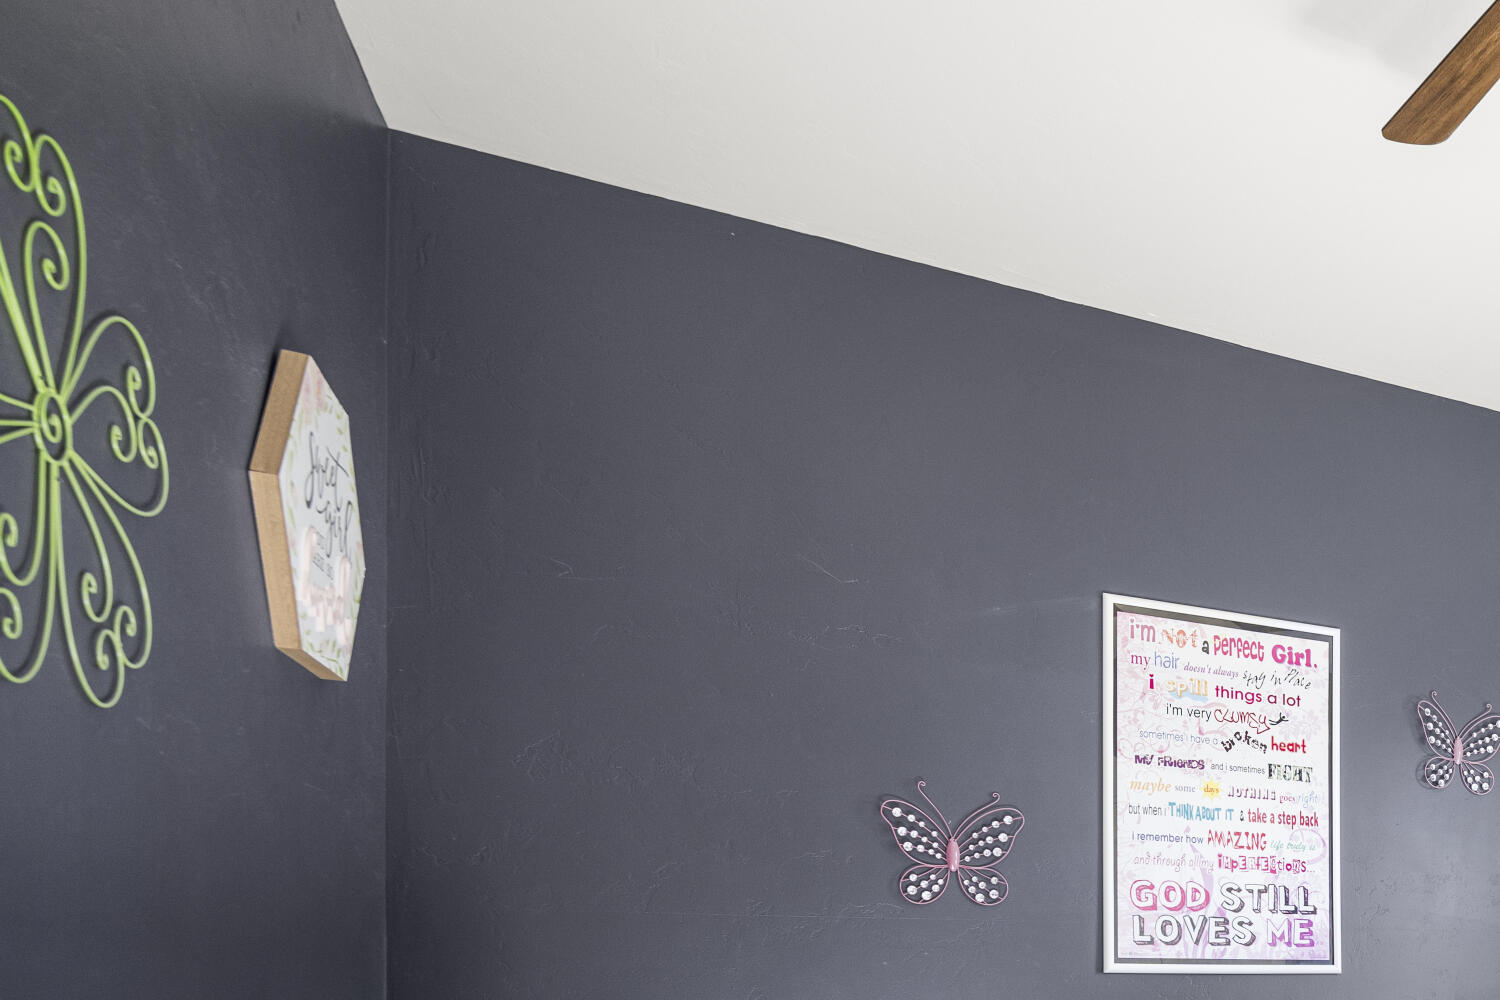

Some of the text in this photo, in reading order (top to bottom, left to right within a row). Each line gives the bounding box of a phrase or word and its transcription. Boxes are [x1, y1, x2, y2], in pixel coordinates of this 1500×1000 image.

[1130, 618, 1156, 642] i'm
[1201, 640, 1210, 654] a
[1271, 644, 1318, 669] Girl.
[1131, 654, 1151, 670] my
[1154, 651, 1180, 669] hair
[1184, 662, 1211, 674] doesn't
[1213, 666, 1239, 679] always
[1243, 670, 1266, 690] stay
[1271, 670, 1281, 686] in
[1149, 673, 1301, 707] i spill things a lot
[1166, 703, 1183, 717] i'm
[1187, 707, 1212, 722] very
[1139, 730, 1184, 742] sometimes
[1190, 734, 1211, 744] have
[1220, 730, 1268, 754] broken
[1271, 736, 1307, 754] heart
[1211, 763, 1224, 771] and
[1229, 764, 1266, 775] sometimes
[1268, 763, 1313, 783] FIGHT
[1129, 777, 1172, 796] maybe
[1174, 785, 1196, 793] some
[1203, 784, 1219, 795] days
[1280, 795, 1296, 804] goes
[1299, 791, 1318, 808] right
[1128, 803, 1141, 815] but
[1142, 804, 1162, 816] when
[1195, 806, 1222, 821] ABOUT
[1225, 807, 1234, 821] IT
[1248, 808, 1267, 824] take
[1269, 812, 1275, 824] a
[1277, 811, 1297, 830] step
[1300, 810, 1319, 827] back
[1137, 832, 1184, 843] remember
[1186, 834, 1204, 845] how
[1207, 829, 1267, 851] AMAZING
[1271, 840, 1284, 851] life
[1134, 851, 1150, 866] and
[1153, 852, 1186, 873] through
[1189, 854, 1200, 869] all
[1130, 879, 1318, 915] GOD STILL
[1132, 914, 1315, 948] LOVES ME
